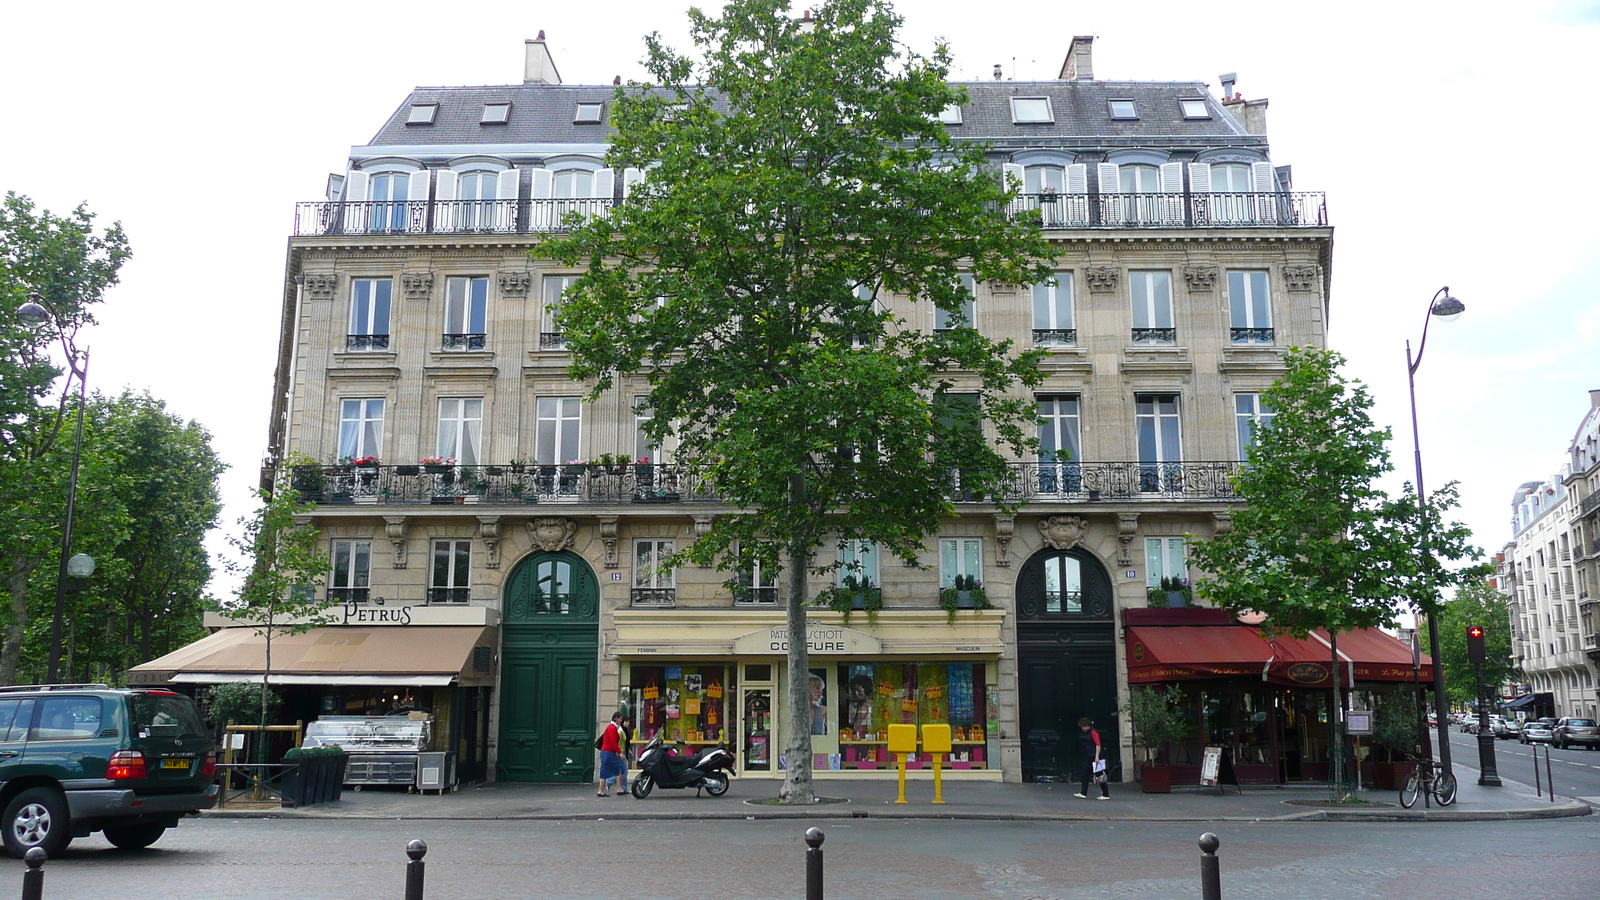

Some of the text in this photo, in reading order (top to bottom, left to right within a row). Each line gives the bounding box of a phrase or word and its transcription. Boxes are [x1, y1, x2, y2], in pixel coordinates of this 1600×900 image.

[1127, 570, 1135, 578] 10
[342, 600, 411, 625] PETRUS
[770, 642, 844, 651] COFURE
